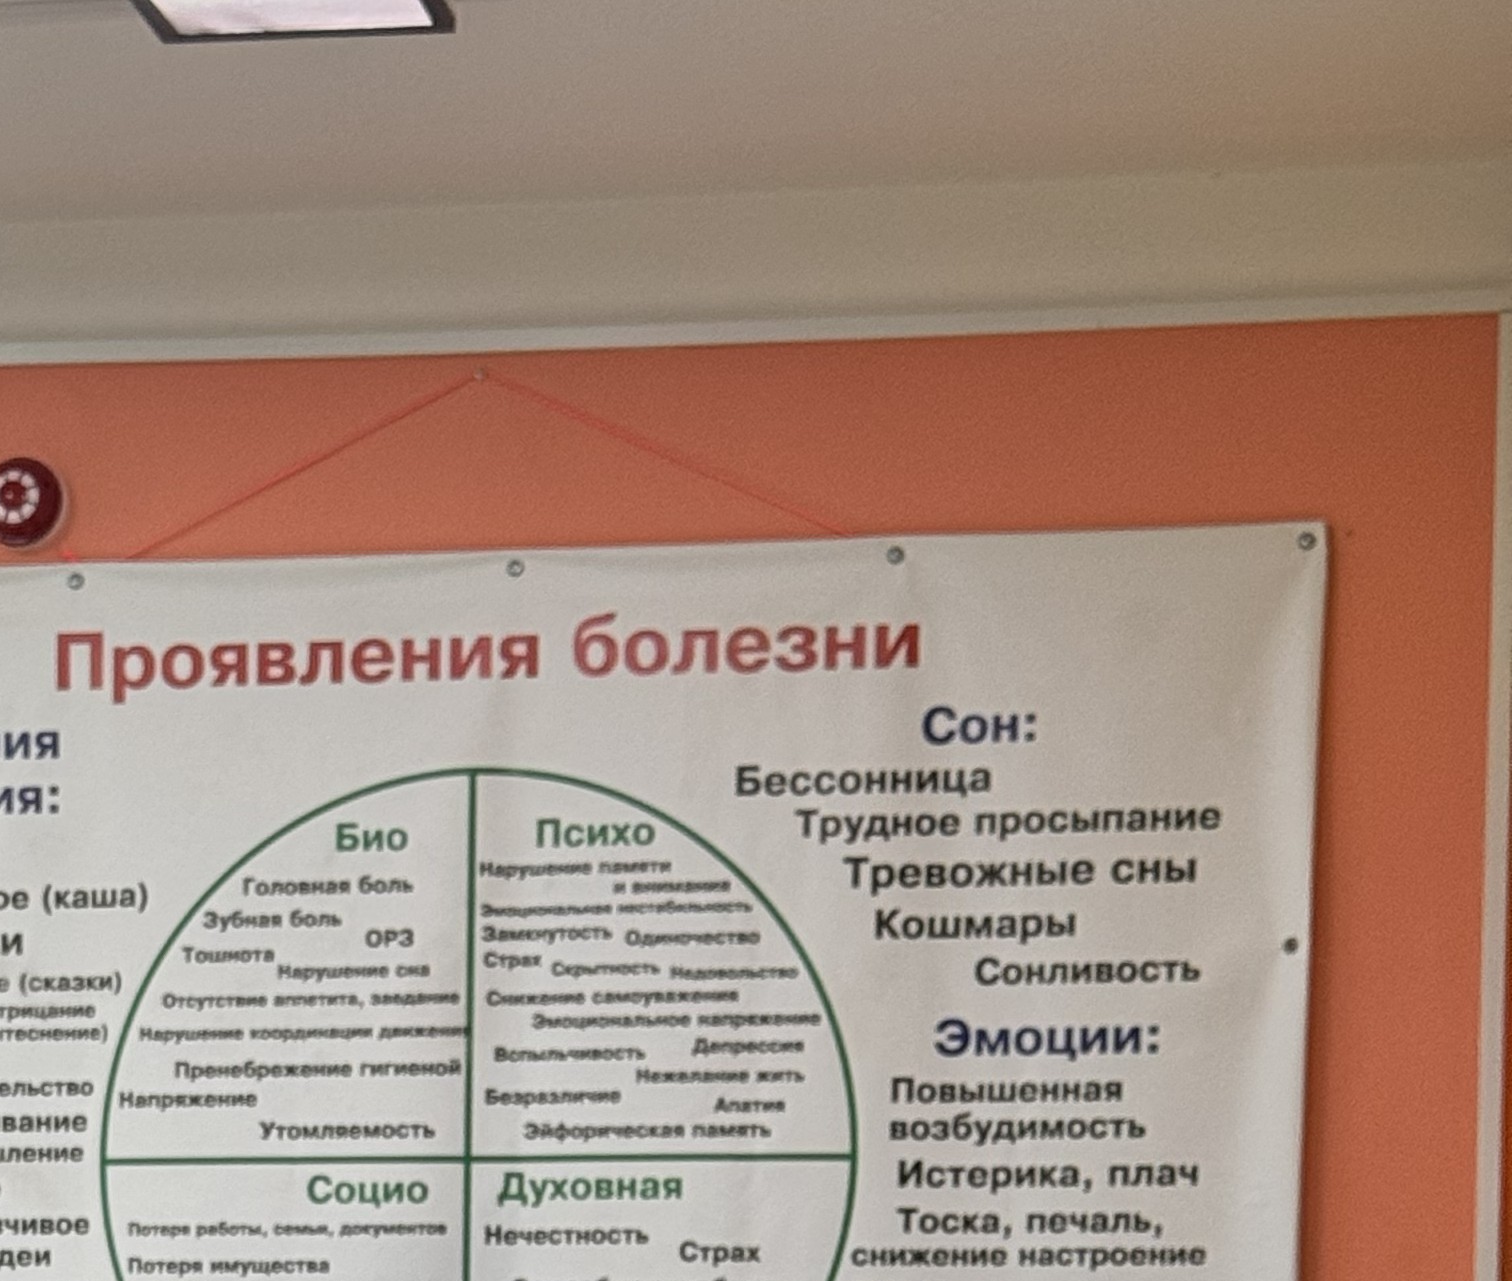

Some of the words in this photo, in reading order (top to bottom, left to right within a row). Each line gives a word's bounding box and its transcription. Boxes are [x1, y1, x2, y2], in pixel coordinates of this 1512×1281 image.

[57, 632, 540, 704] Проявления
[574, 612, 920, 677] болезни
[922, 706, 1036, 746] Сон:
[736, 765, 991, 797] Бессонница
[336, 822, 408, 852] Био
[536, 818, 655, 848] Психо
[795, 809, 960, 844] Трудное
[975, 807, 1221, 841] просыпание
[243, 877, 351, 896] Головная
[358, 875, 414, 894] боль
[843, 856, 1095, 896] Тревожные
[1111, 858, 1197, 884] сны
[42, 882, 148, 915] (каша)
[203, 910, 282, 932] Зубная
[289, 909, 342, 928] боль
[875, 909, 1076, 944] Кошмары
[365, 928, 414, 948] ОРЗ
[481, 925, 612, 944] Замкнутость
[625, 929, 761, 948] Одиночество
[182, 946, 275, 964] Тошнота
[483, 951, 541, 971] Страх
[19, 972, 121, 995] (сказки)
[975, 957, 1200, 986] Сонливость
[935, 1018, 1159, 1061] Эмоции:
[175, 1060, 352, 1082] Пренебрежение
[360, 1058, 462, 1076] гигиеной
[119, 1092, 257, 1112] Напряжение
[891, 1077, 1122, 1104] Повышенная
[259, 1121, 435, 1140] Утомляемость
[889, 1112, 1146, 1146] возбудимость
[307, 1175, 429, 1208] Социо
[497, 1172, 682, 1208] Духовная
[898, 1160, 1092, 1194] Истерика,
[1109, 1164, 1198, 1186] плач
[484, 1224, 649, 1246] Нечестность
[897, 1207, 1011, 1239] Тоска,
[1026, 1212, 1163, 1238] печаль,
[128, 1257, 203, 1277] Потеря
[210, 1260, 330, 1277] имущества
[679, 1241, 760, 1267] Страх
[851, 1248, 1007, 1267] снижение
[1019, 1247, 1206, 1271] настроение
